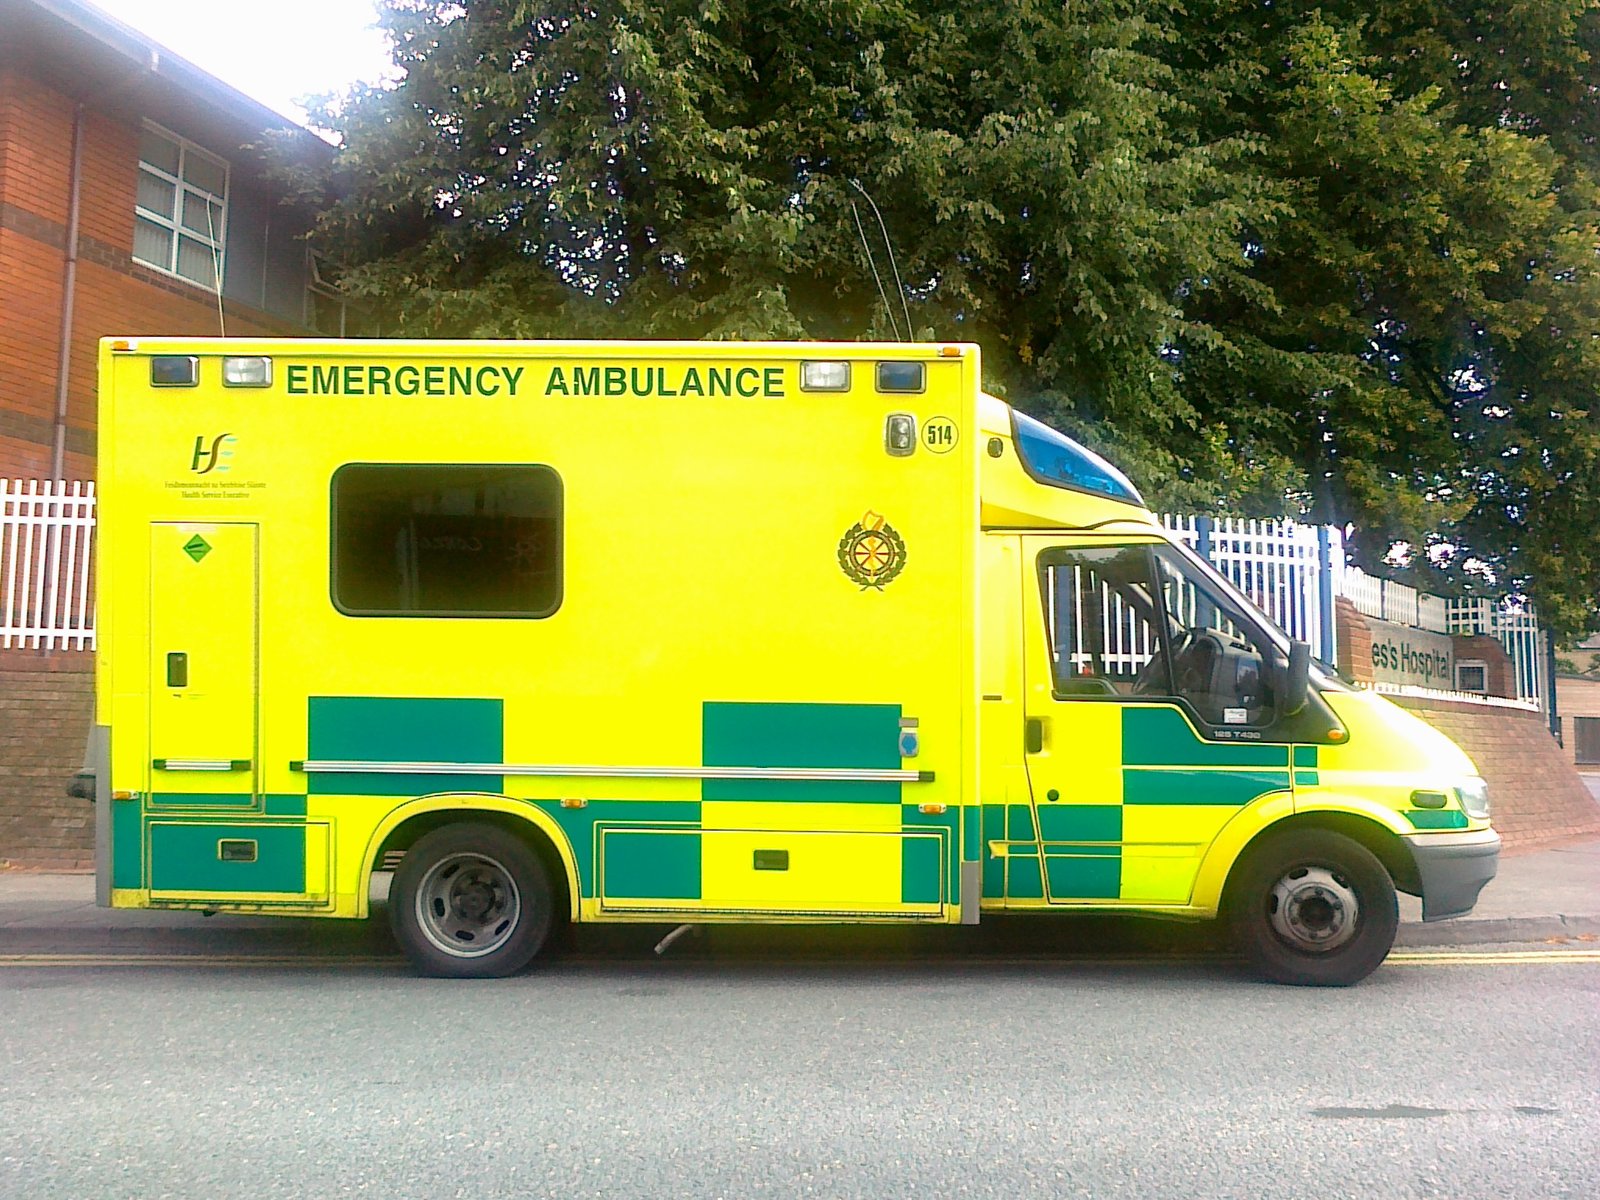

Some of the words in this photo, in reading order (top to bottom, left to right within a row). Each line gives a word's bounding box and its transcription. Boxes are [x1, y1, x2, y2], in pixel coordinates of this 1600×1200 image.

[287, 365, 524, 396] EMERGENCY
[545, 367, 785, 397] AMBULANCE
[928, 425, 952, 445] 514
[1401, 641, 1451, 683] Hospital
